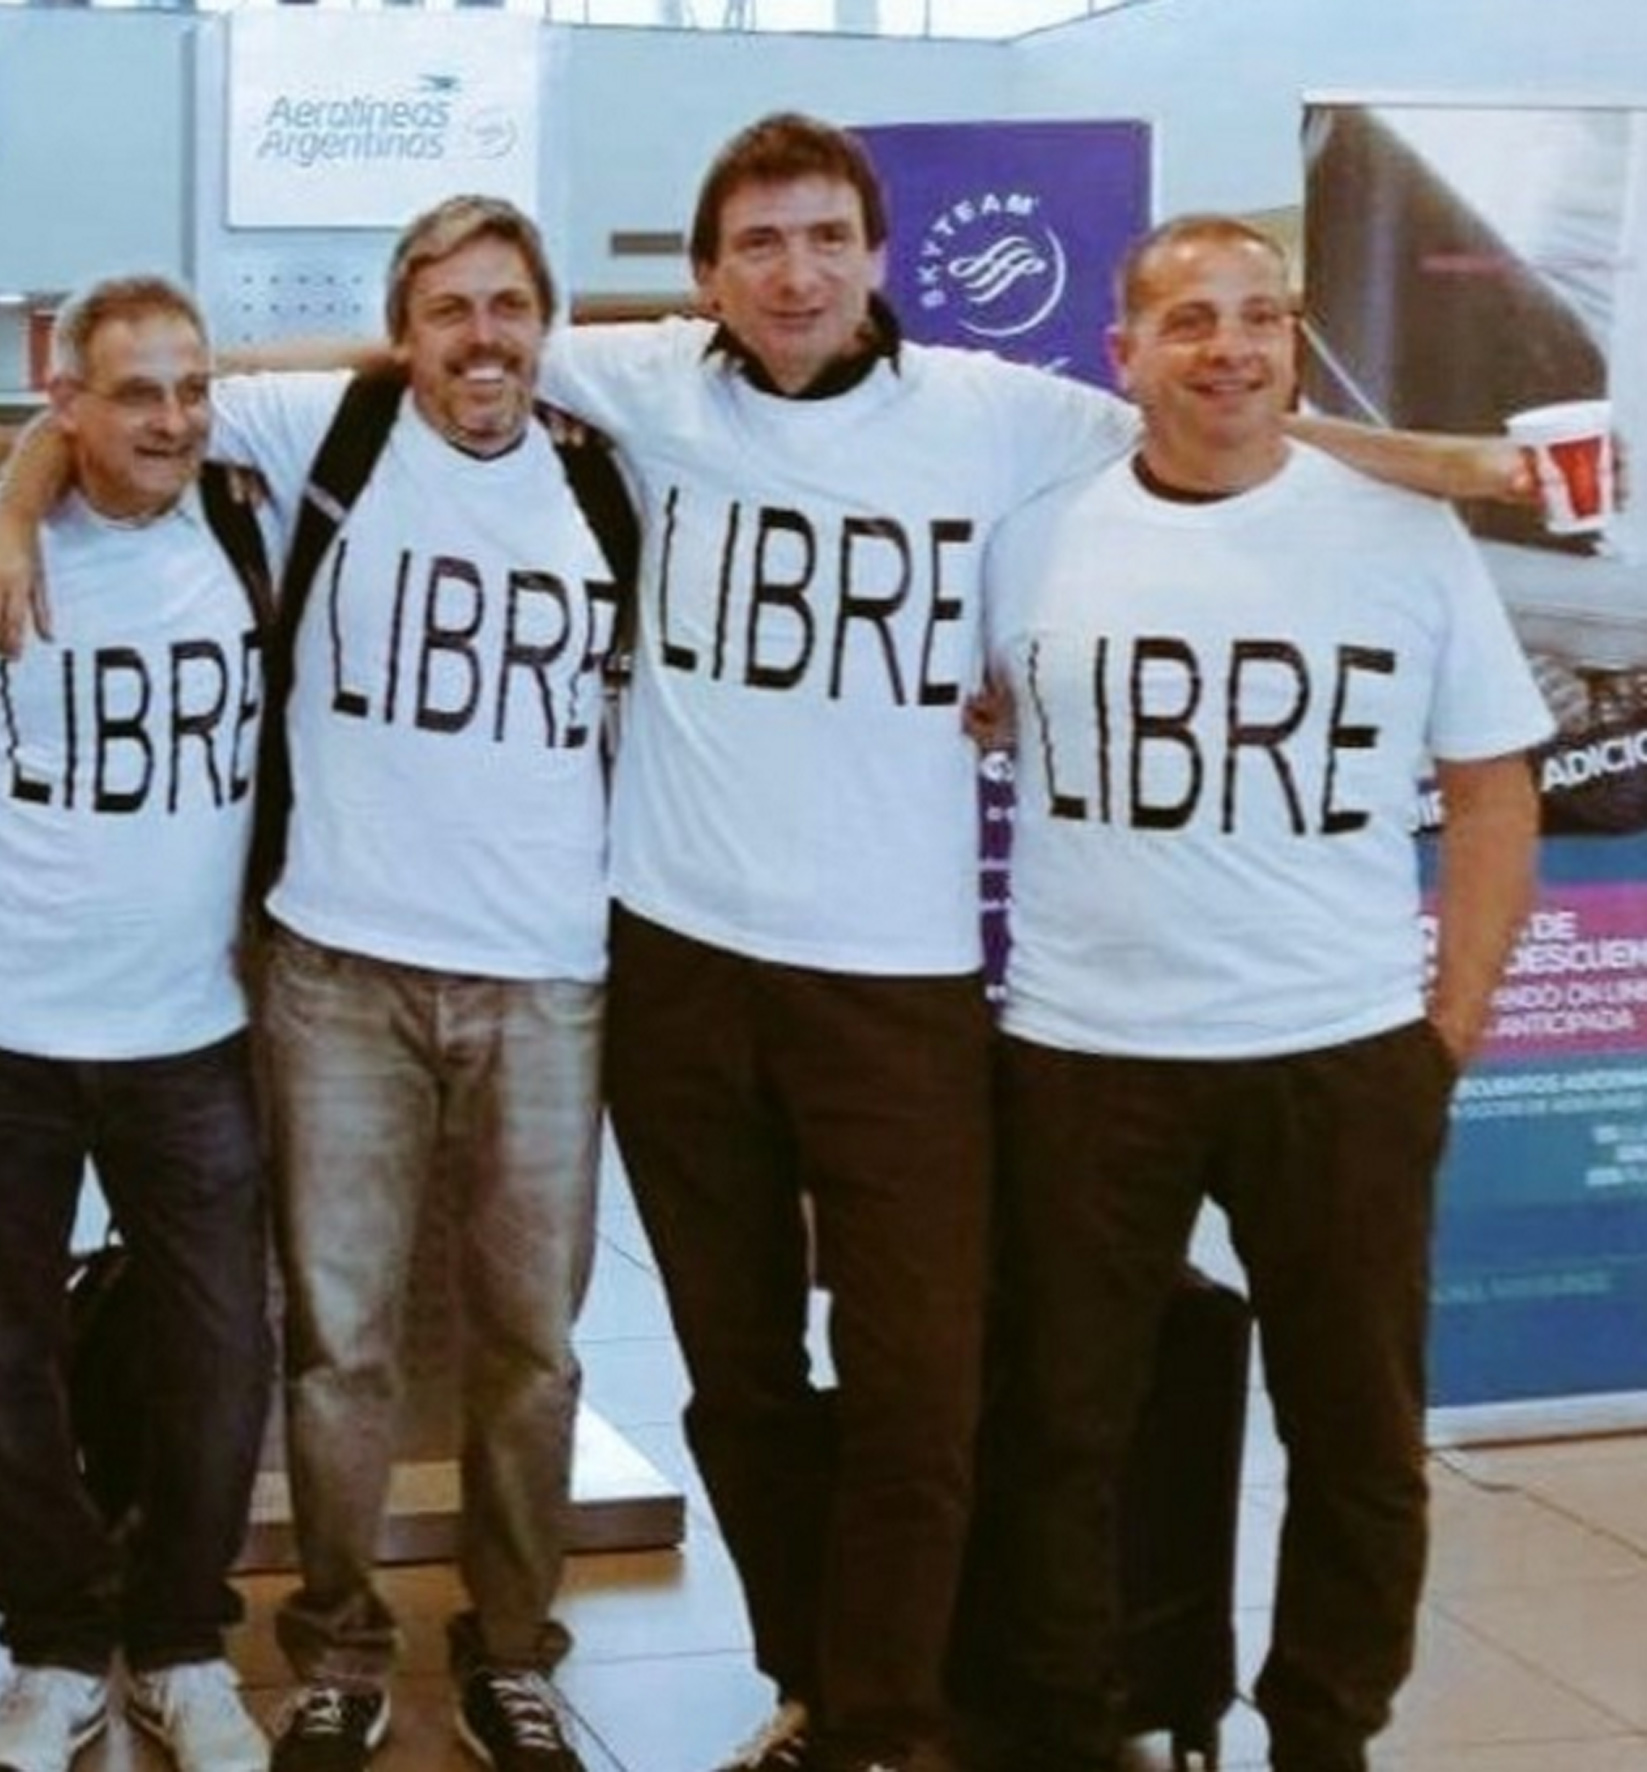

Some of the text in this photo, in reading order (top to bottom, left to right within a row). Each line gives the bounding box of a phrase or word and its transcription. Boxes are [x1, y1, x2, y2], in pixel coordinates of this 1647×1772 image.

[256, 130, 445, 167] Argentinas
[916, 193, 1034, 308] SKYTEAM
[660, 486, 974, 706] LIBRE
[1028, 635, 1396, 835] LIBRE
